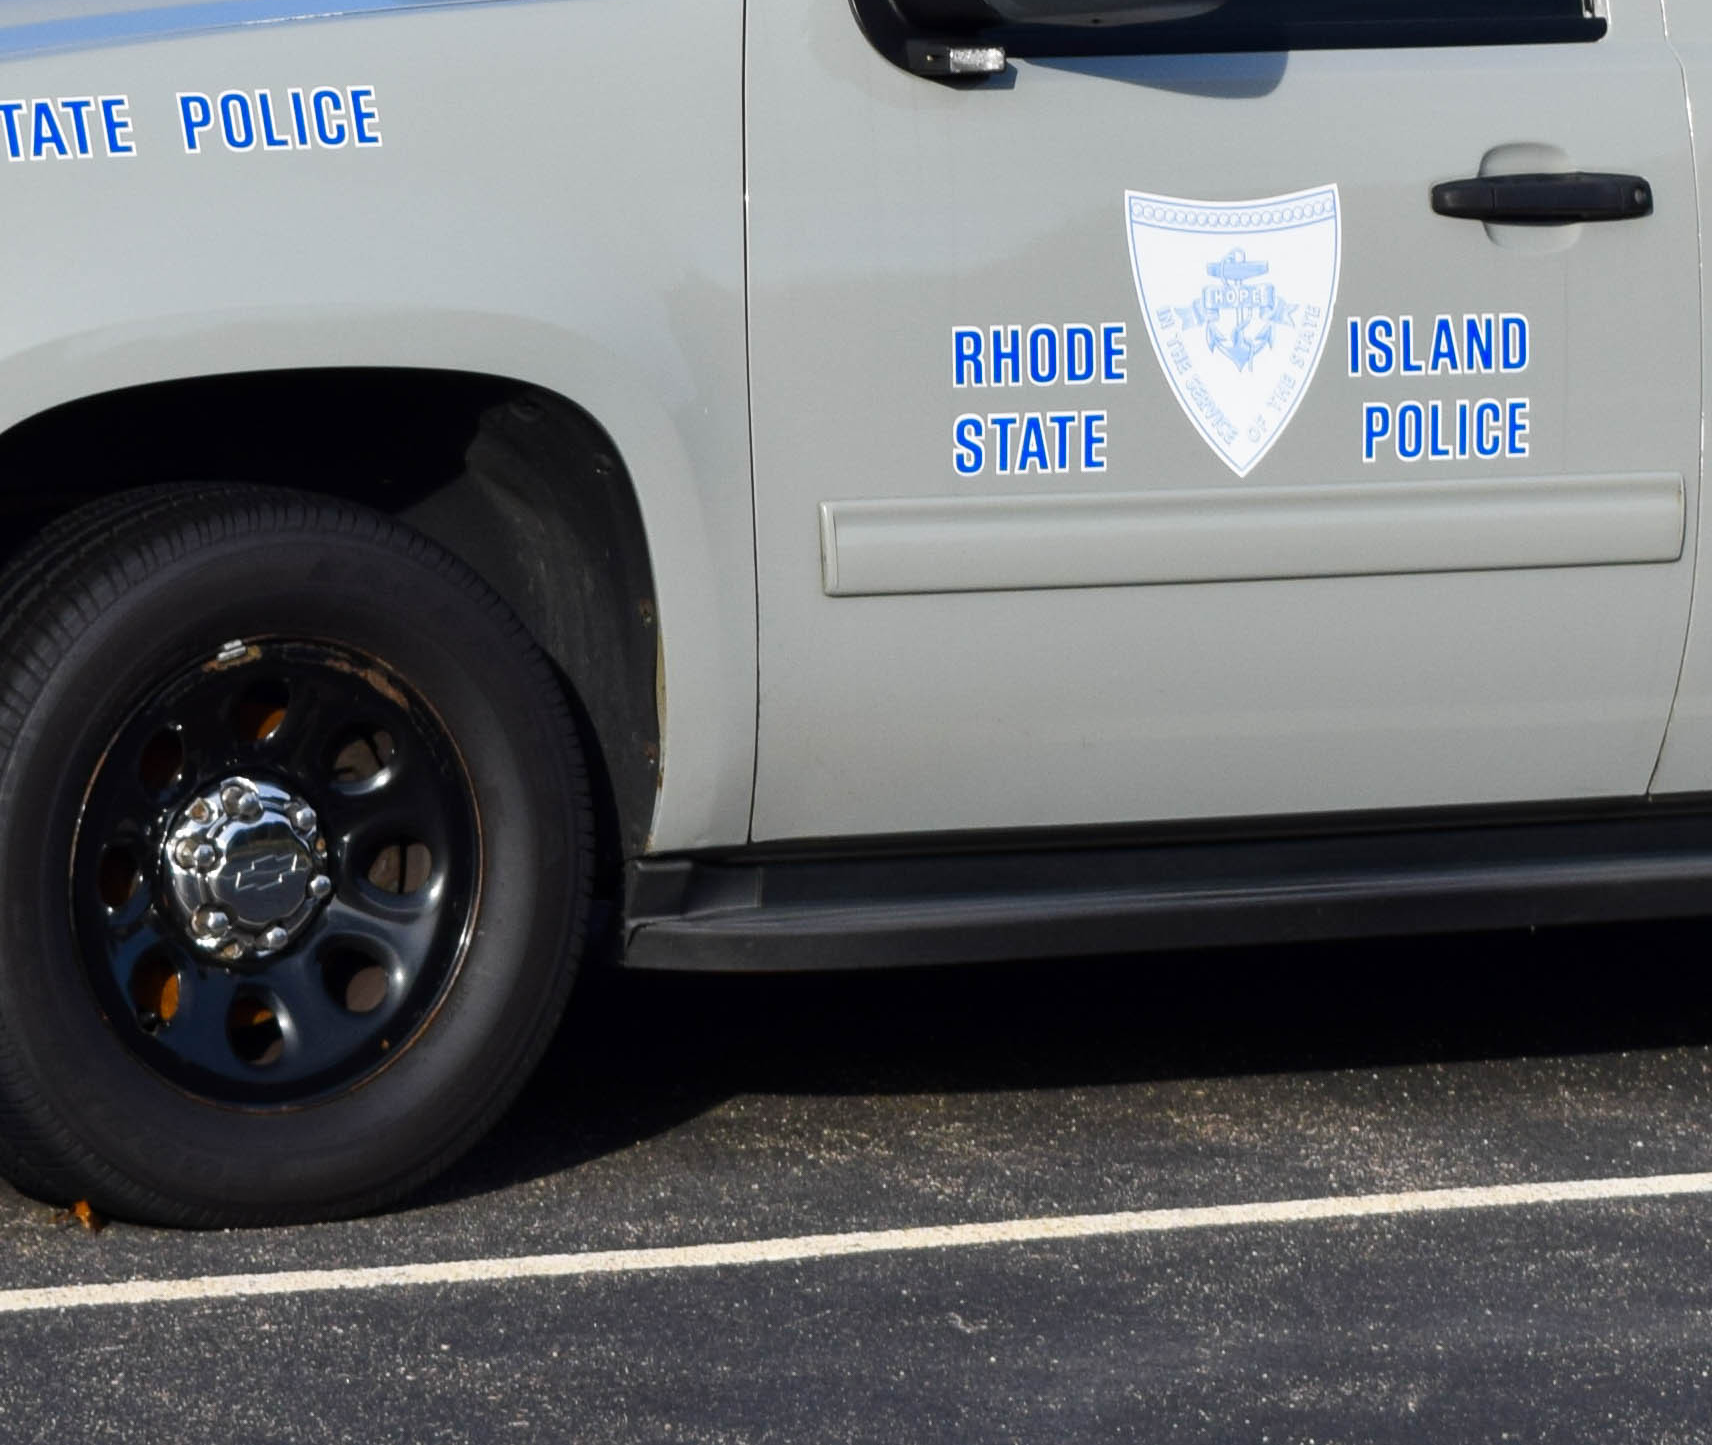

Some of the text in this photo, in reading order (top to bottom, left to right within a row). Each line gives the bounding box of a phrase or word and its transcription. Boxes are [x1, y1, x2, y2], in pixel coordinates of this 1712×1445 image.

[178, 87, 382, 151] POLICE
[1214, 287, 1263, 304] HOPE
[952, 314, 1529, 388] RHODE ISLAND
[953, 398, 1529, 476] STATE POLICE
